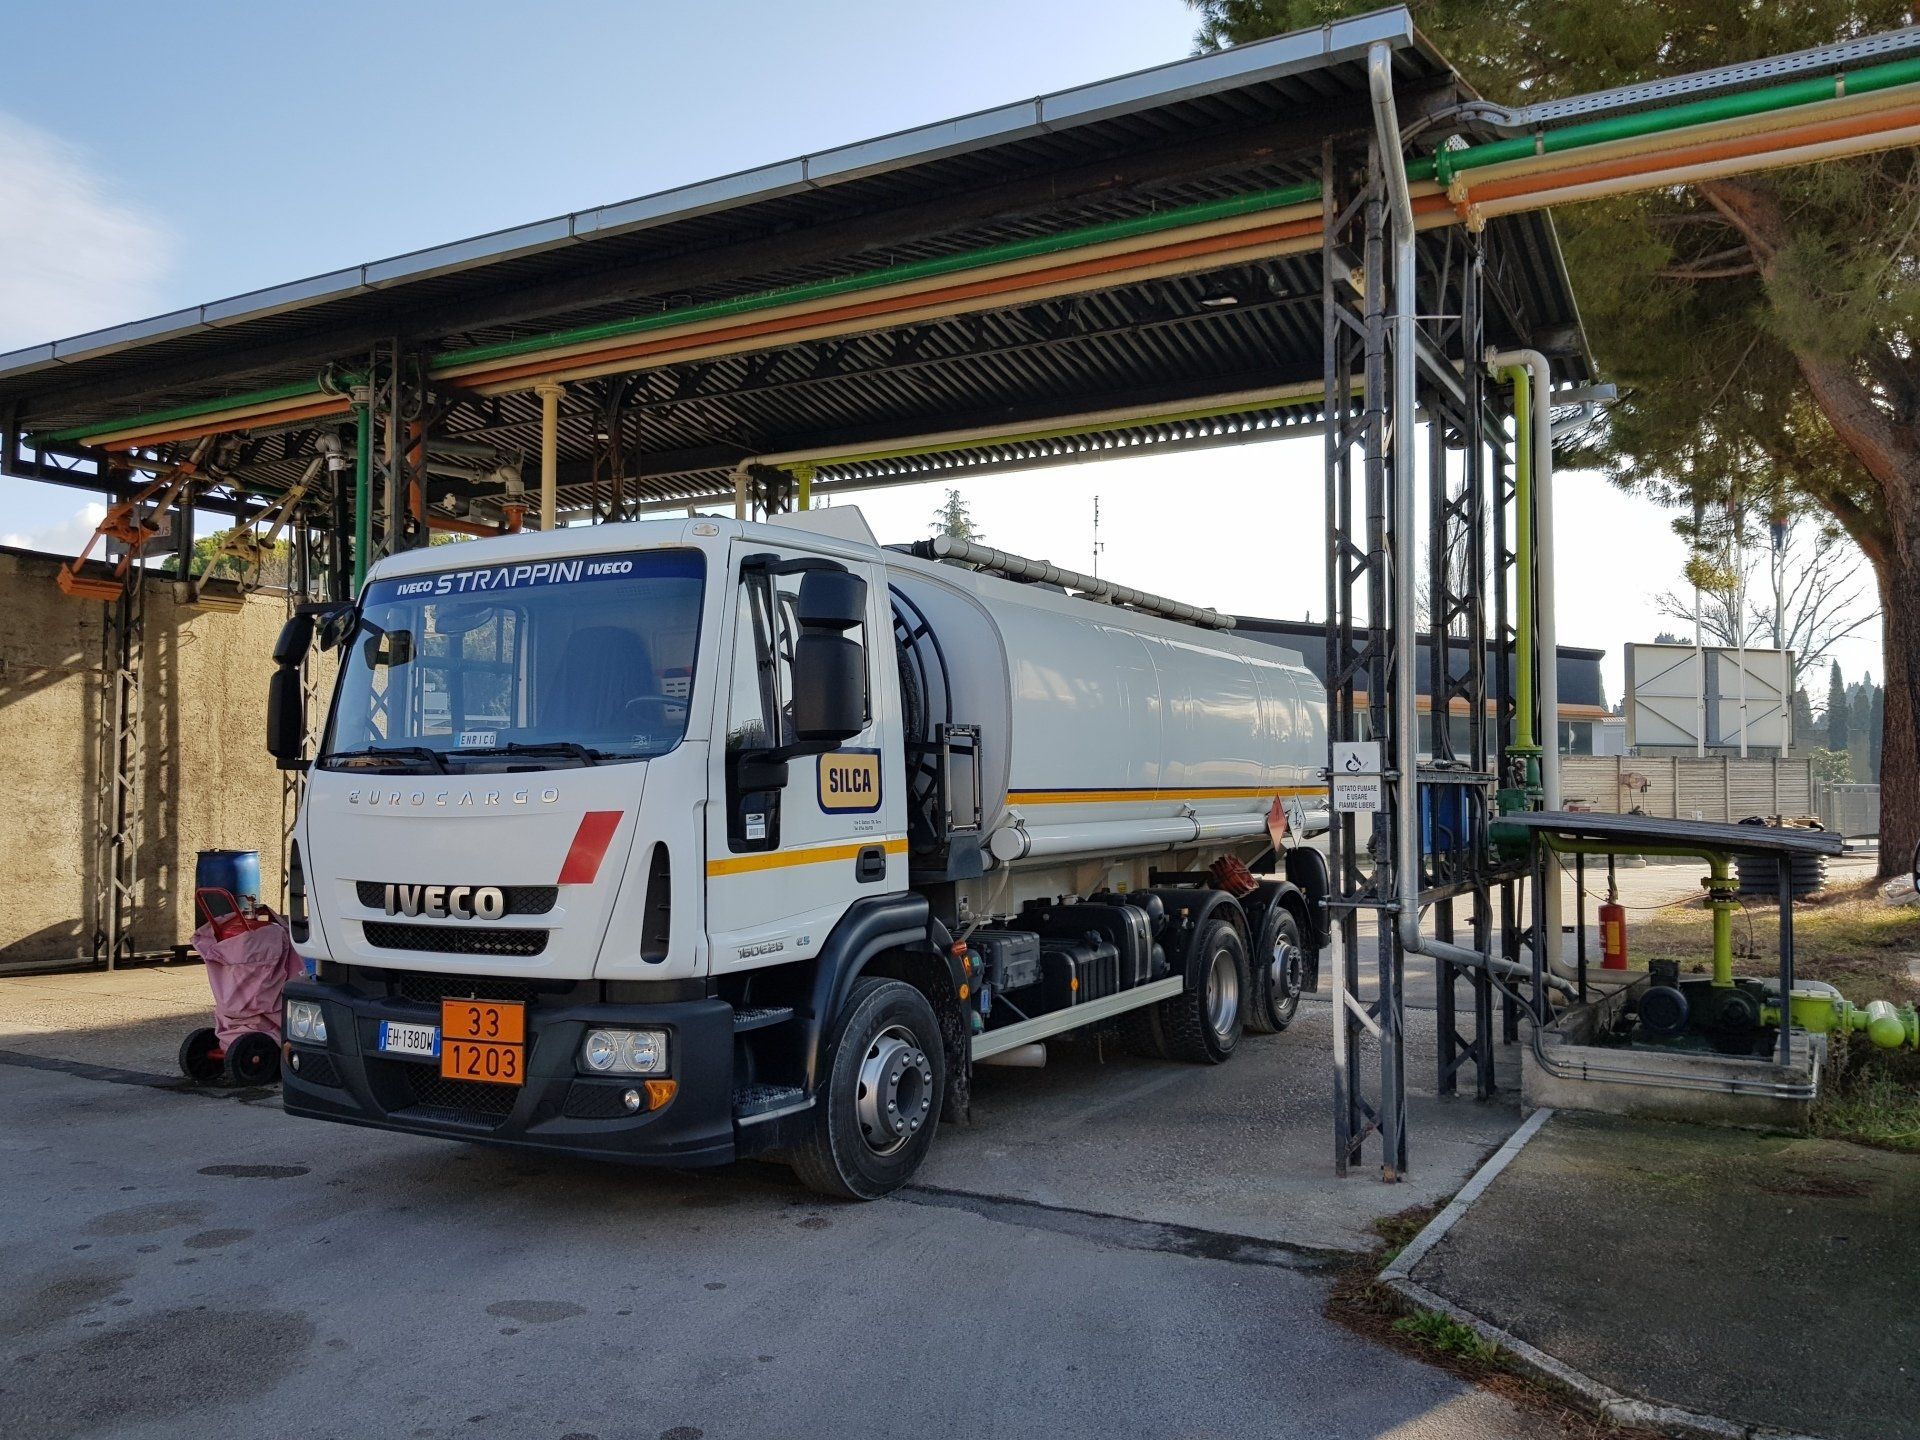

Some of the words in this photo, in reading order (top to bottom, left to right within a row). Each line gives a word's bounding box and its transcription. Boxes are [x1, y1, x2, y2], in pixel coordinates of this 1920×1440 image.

[396, 580, 433, 596] IVECO
[434, 560, 584, 595] STRAPPINI
[587, 560, 633, 576] IVECO
[460, 735, 496, 745] ENRICO
[829, 767, 872, 793] SILCA
[348, 786, 560, 807] EUROCARGO
[384, 884, 504, 920] IVECO
[468, 1007, 500, 1037] 33
[453, 1045, 516, 1078] 1203
